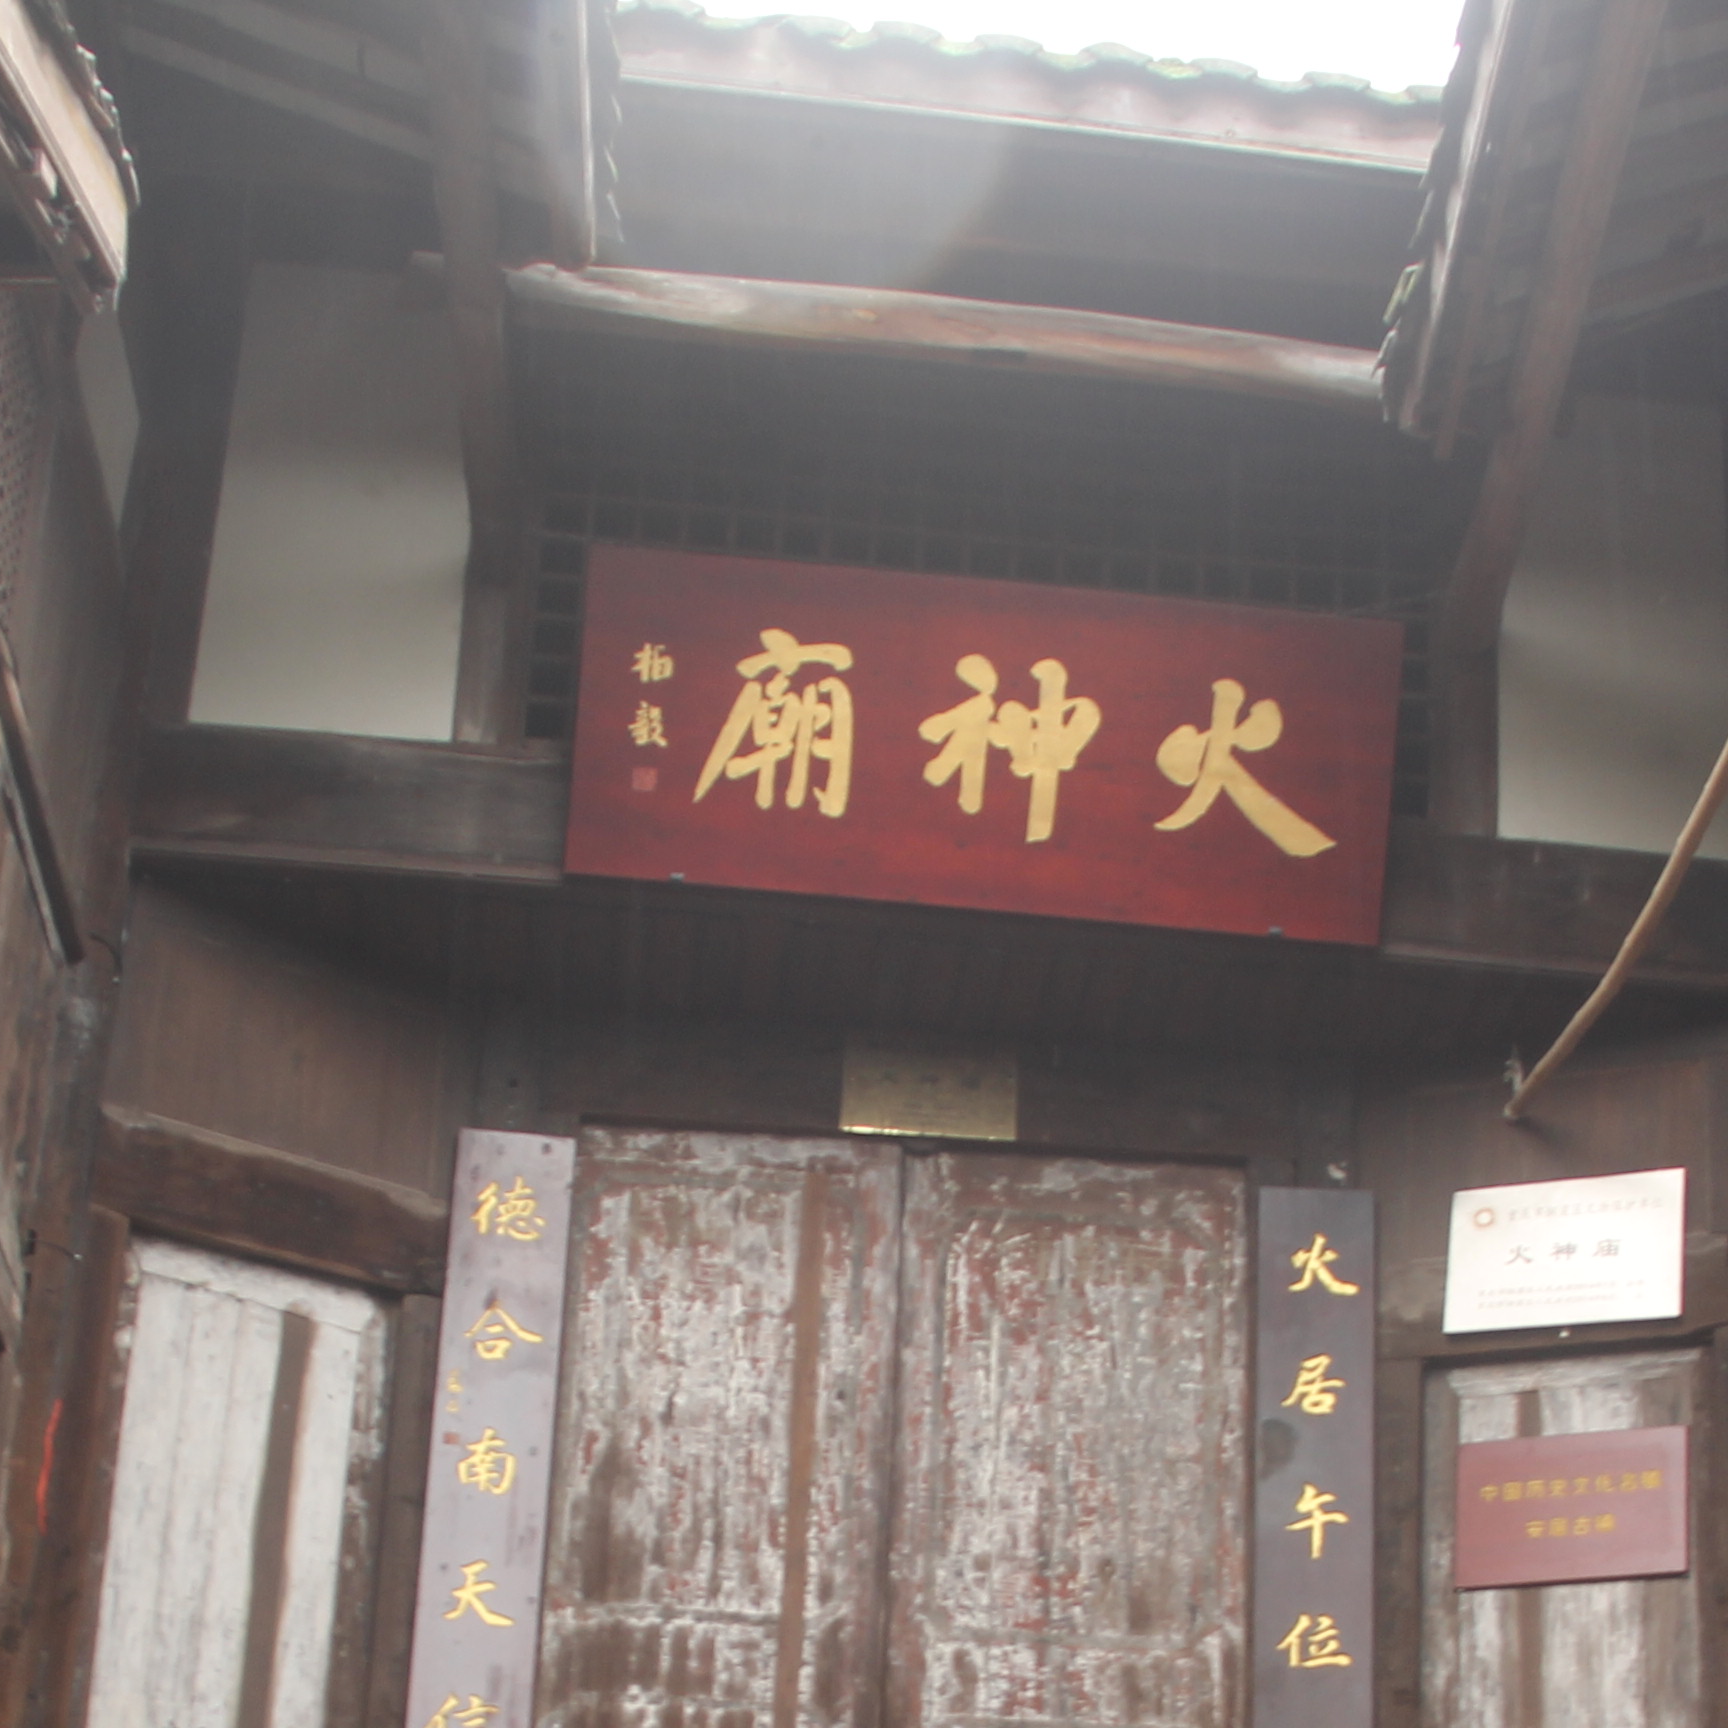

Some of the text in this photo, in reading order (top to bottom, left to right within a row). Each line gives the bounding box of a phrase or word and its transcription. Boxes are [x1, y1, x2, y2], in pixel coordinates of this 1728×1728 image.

[694, 628, 1338, 860] 火神廟
[1503, 1236, 1625, 1266] 火神庙
